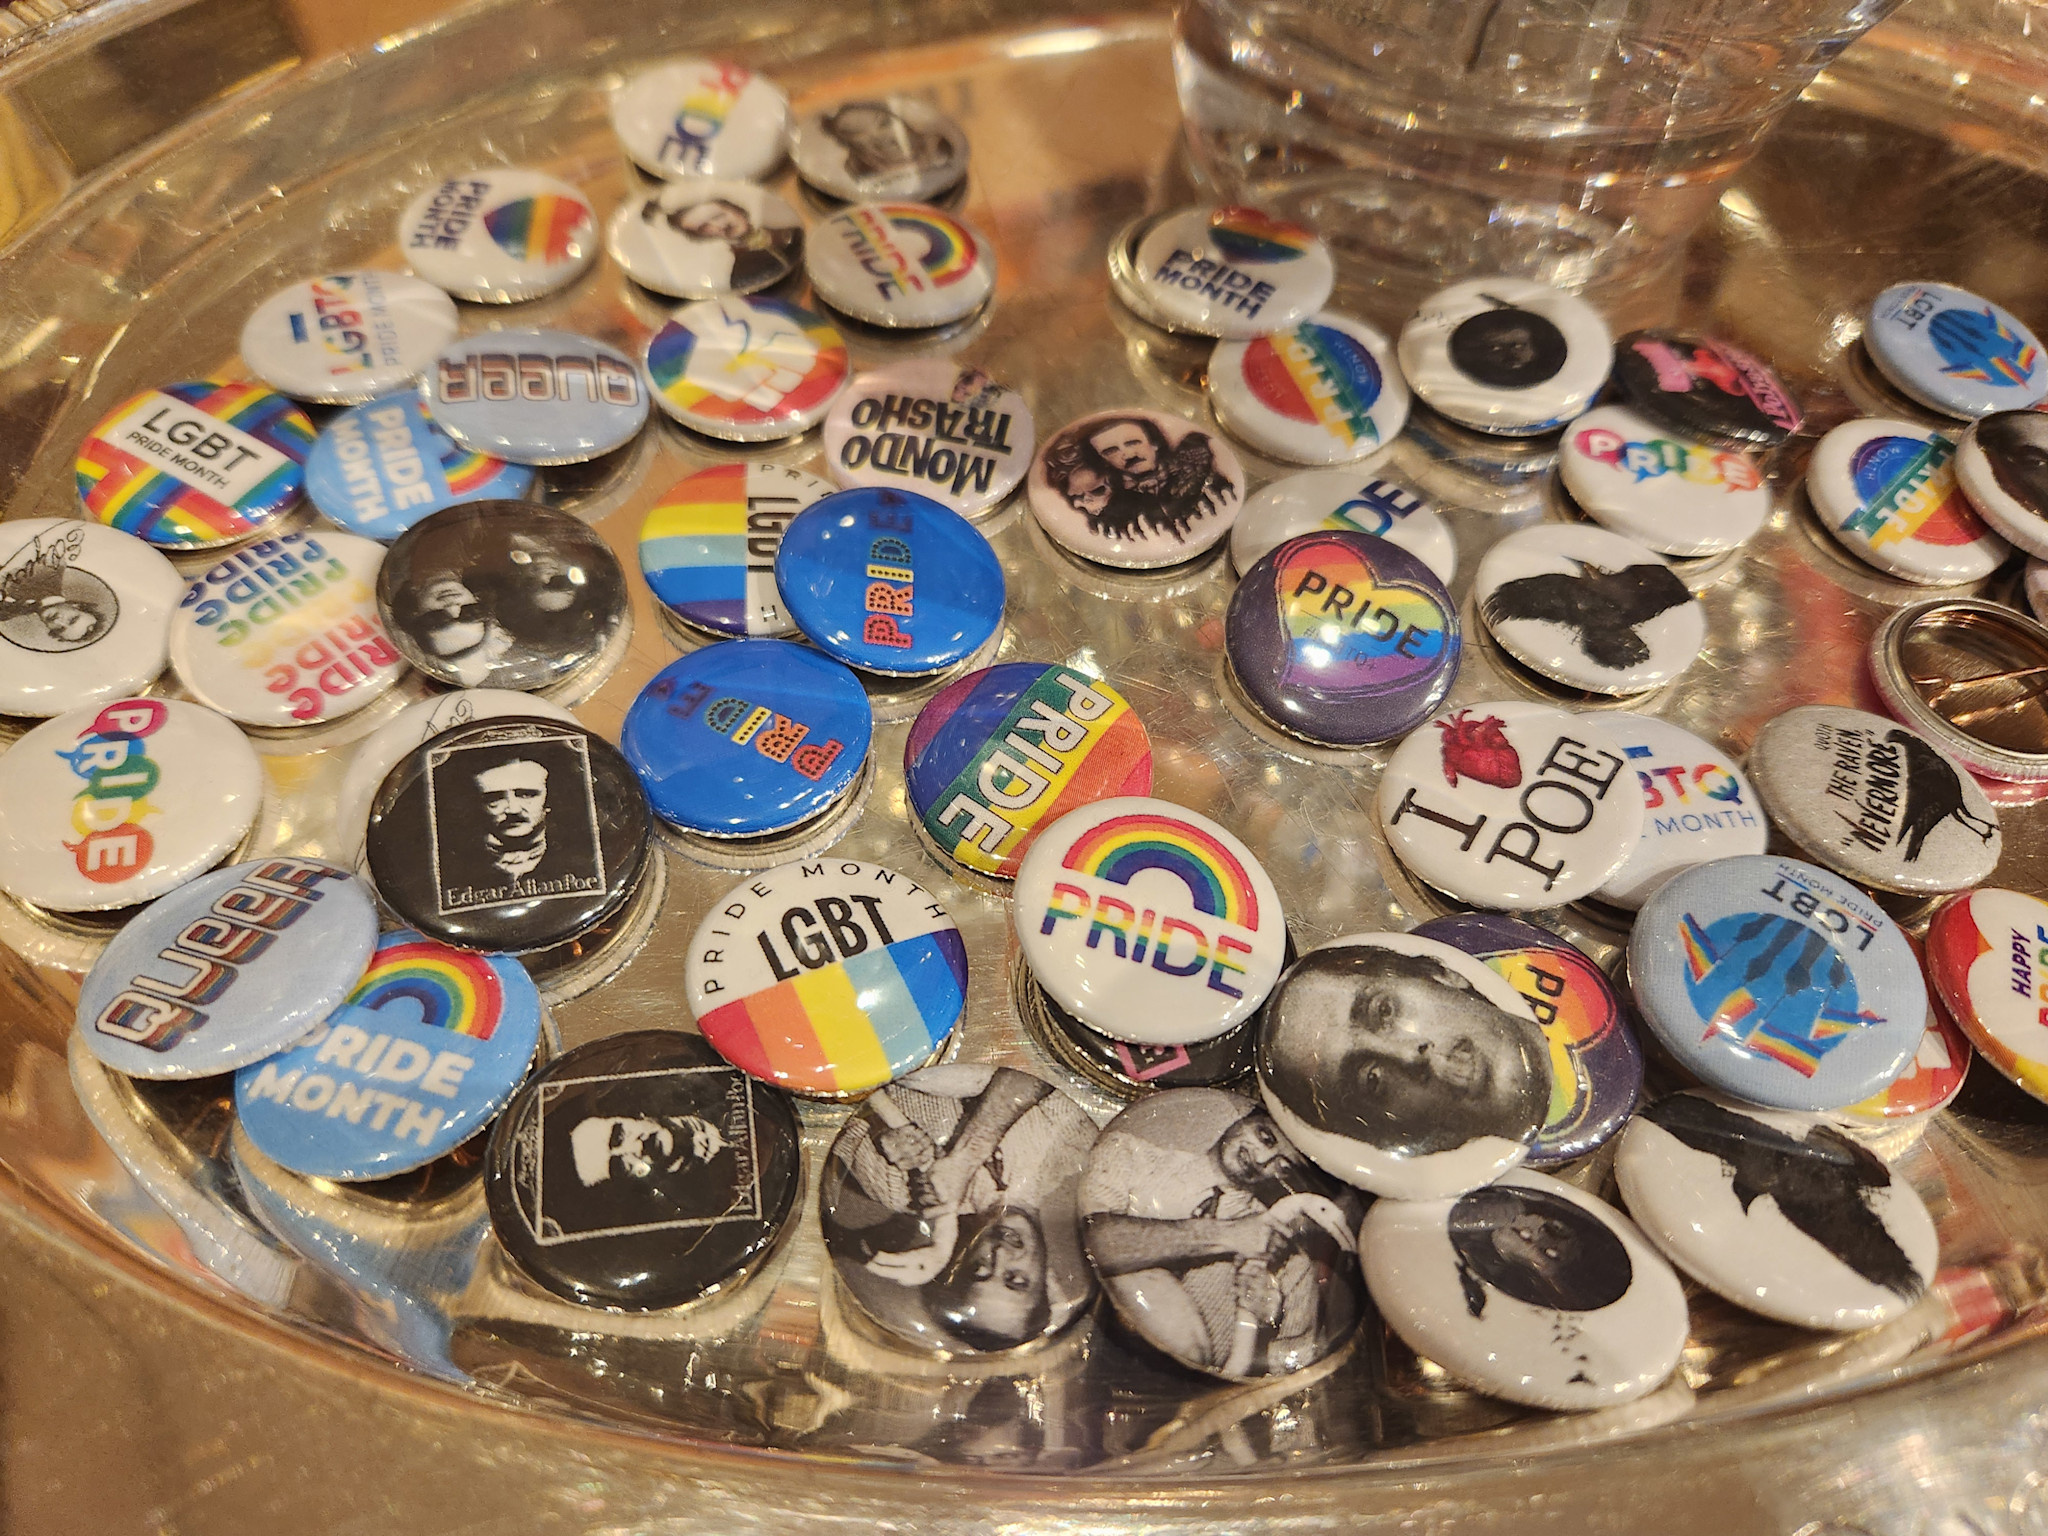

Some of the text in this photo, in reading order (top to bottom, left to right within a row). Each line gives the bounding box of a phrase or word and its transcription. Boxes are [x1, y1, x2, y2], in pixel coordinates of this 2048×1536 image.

[1153, 266, 1263, 319] MONTH
[1163, 249, 1277, 303] PRIDE
[126, 431, 230, 490] PRIDE MONTH
[142, 408, 262, 472] LGBT
[367, 405, 435, 511] PRIDE
[851, 394, 1013, 456] TRASHO
[331, 417, 390, 524] MONTH
[840, 432, 997, 498] MONDO
[1292, 569, 1429, 660] PRIDE
[936, 671, 1115, 856] PRIDE
[1814, 722, 1834, 751] QUOTH
[1825, 727, 1866, 802] THE RAVEN,
[86, 706, 156, 872] PRIDE
[1391, 788, 1488, 852] I
[1485, 736, 1624, 892] POE
[1654, 810, 1758, 836] MONTH
[446, 885, 508, 907] Edgar
[702, 862, 948, 997] PRIDE MONTH
[1778, 863, 1884, 928] PRIDE MONTH
[756, 893, 896, 982] LGBT
[1038, 880, 1255, 1001] PRIDE
[2010, 928, 2032, 999] HAPPY
[246, 1062, 445, 1147] MONTH
